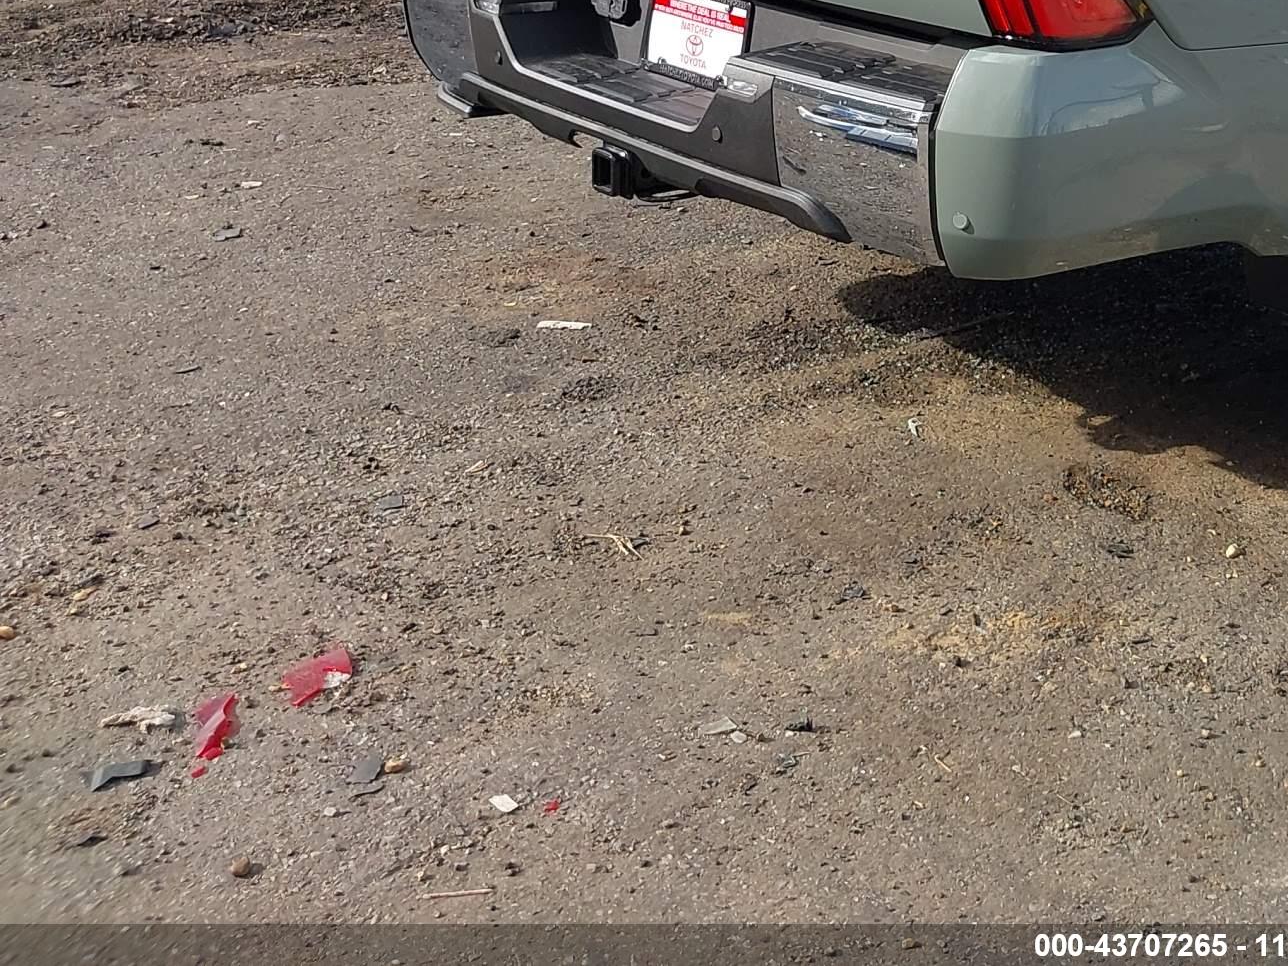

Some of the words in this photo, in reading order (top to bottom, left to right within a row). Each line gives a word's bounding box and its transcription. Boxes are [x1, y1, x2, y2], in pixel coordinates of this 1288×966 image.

[696, 6, 711, 18] DEAL
[680, 20, 714, 38] NATCHEZ
[679, 53, 707, 69] TOYOTA
